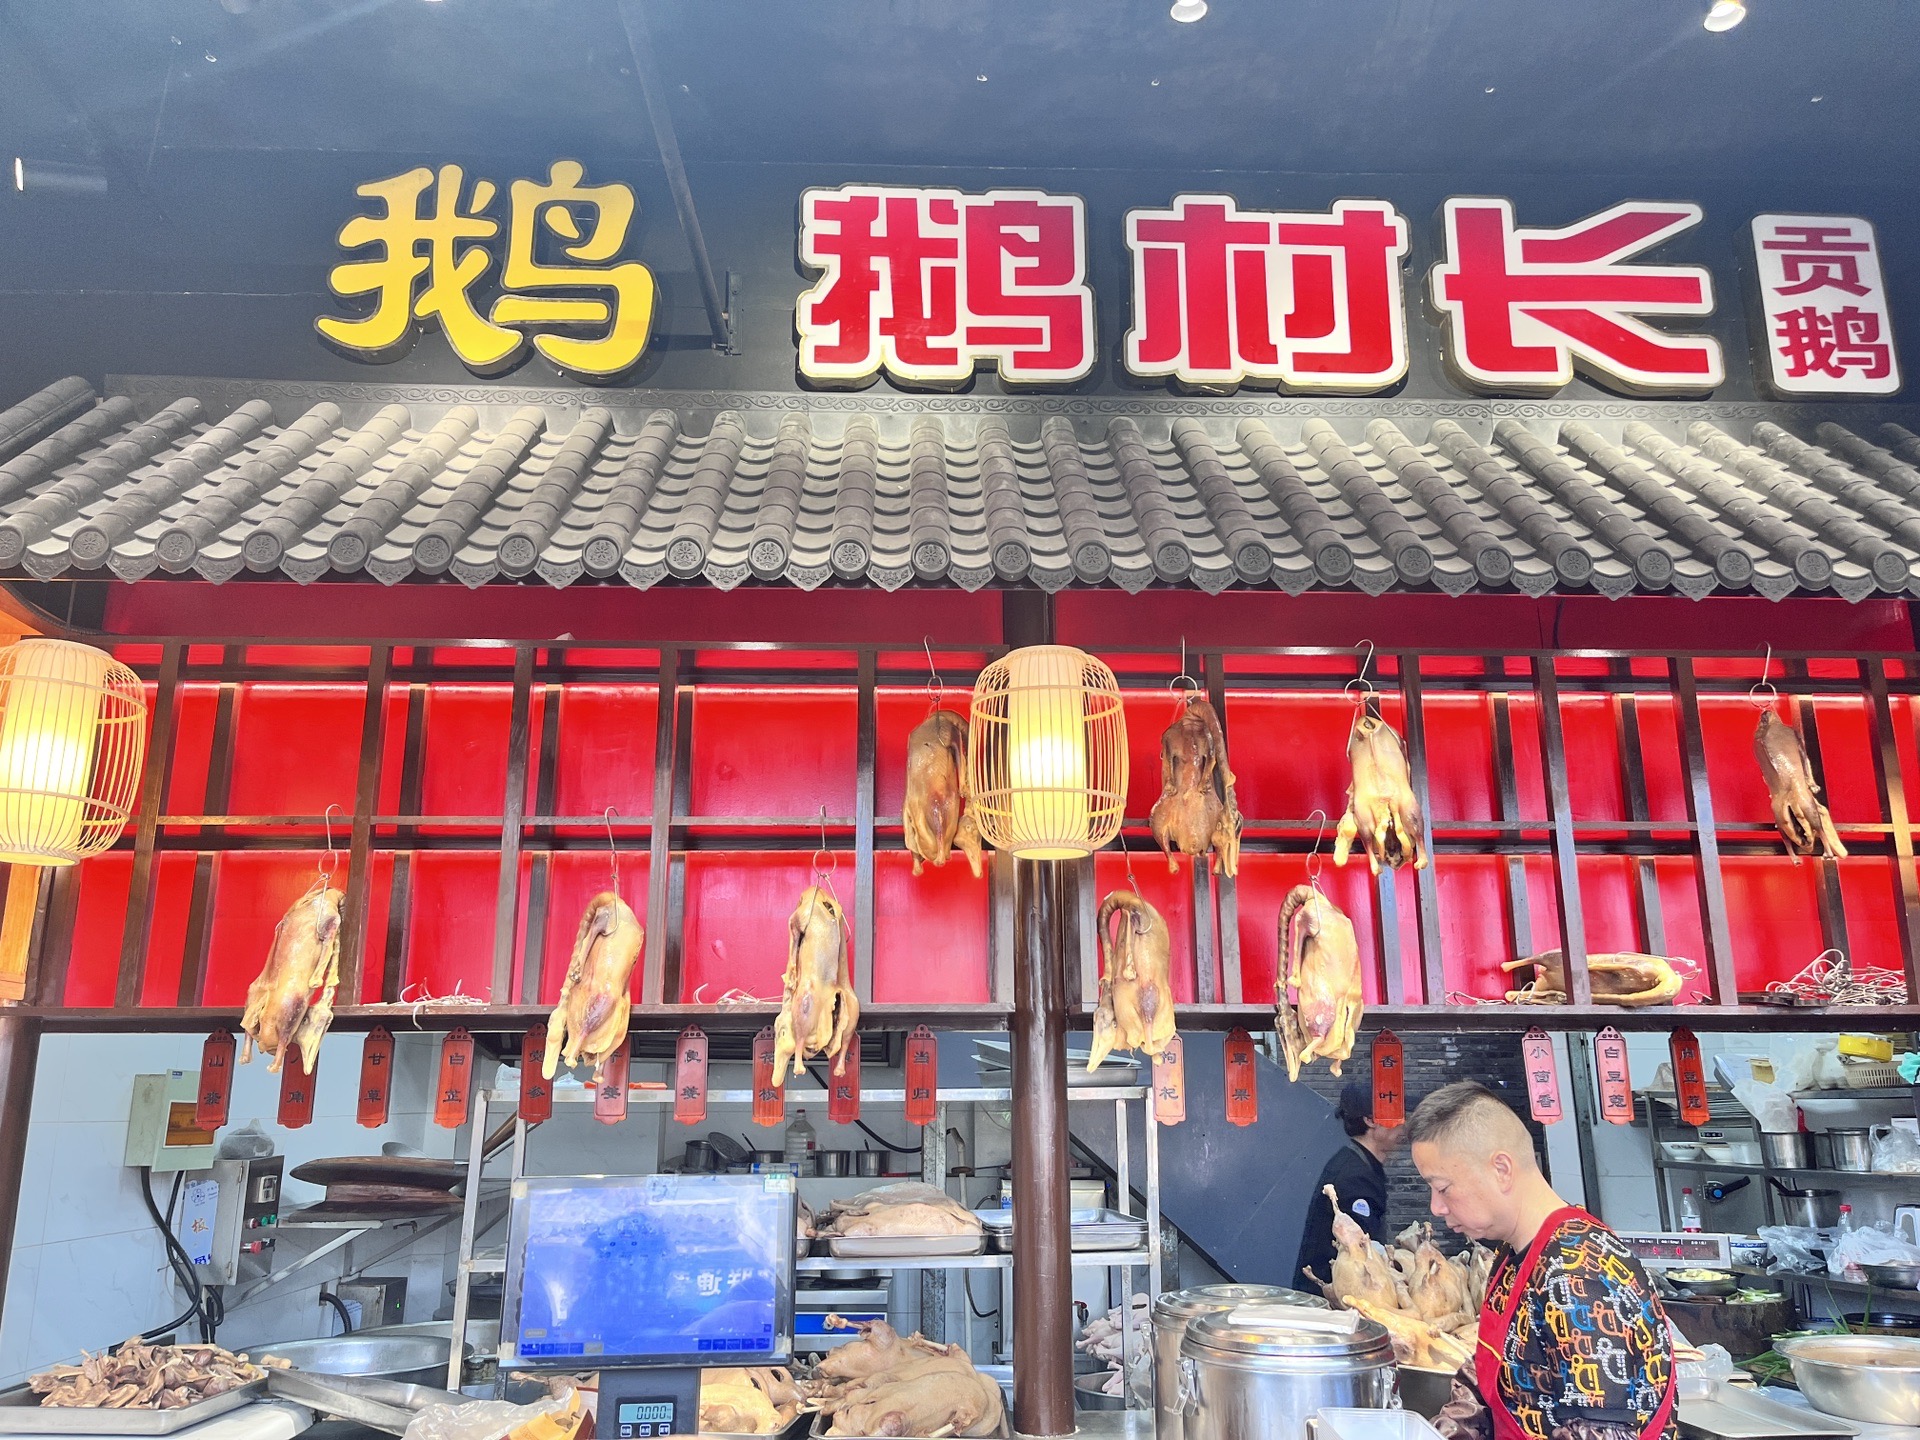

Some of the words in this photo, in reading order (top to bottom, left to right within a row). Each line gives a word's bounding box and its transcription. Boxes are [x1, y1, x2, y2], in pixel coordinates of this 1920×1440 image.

[315, 160, 656, 373] 鹅
[811, 195, 1710, 375] 鹅村长
[1761, 226, 1891, 379] 贡鹅
[358, 1053, 385, 1102] 甘草
[443, 1053, 465, 1103] 白芷
[526, 1049, 546, 1099] 党参
[680, 1049, 702, 1099] 良姜
[912, 1051, 930, 1100] 当归
[1159, 1051, 1179, 1100] 枸杞
[1231, 1052, 1250, 1101] 草果
[1379, 1055, 1398, 1103] 香叶
[1530, 1046, 1555, 1108] 小茴香
